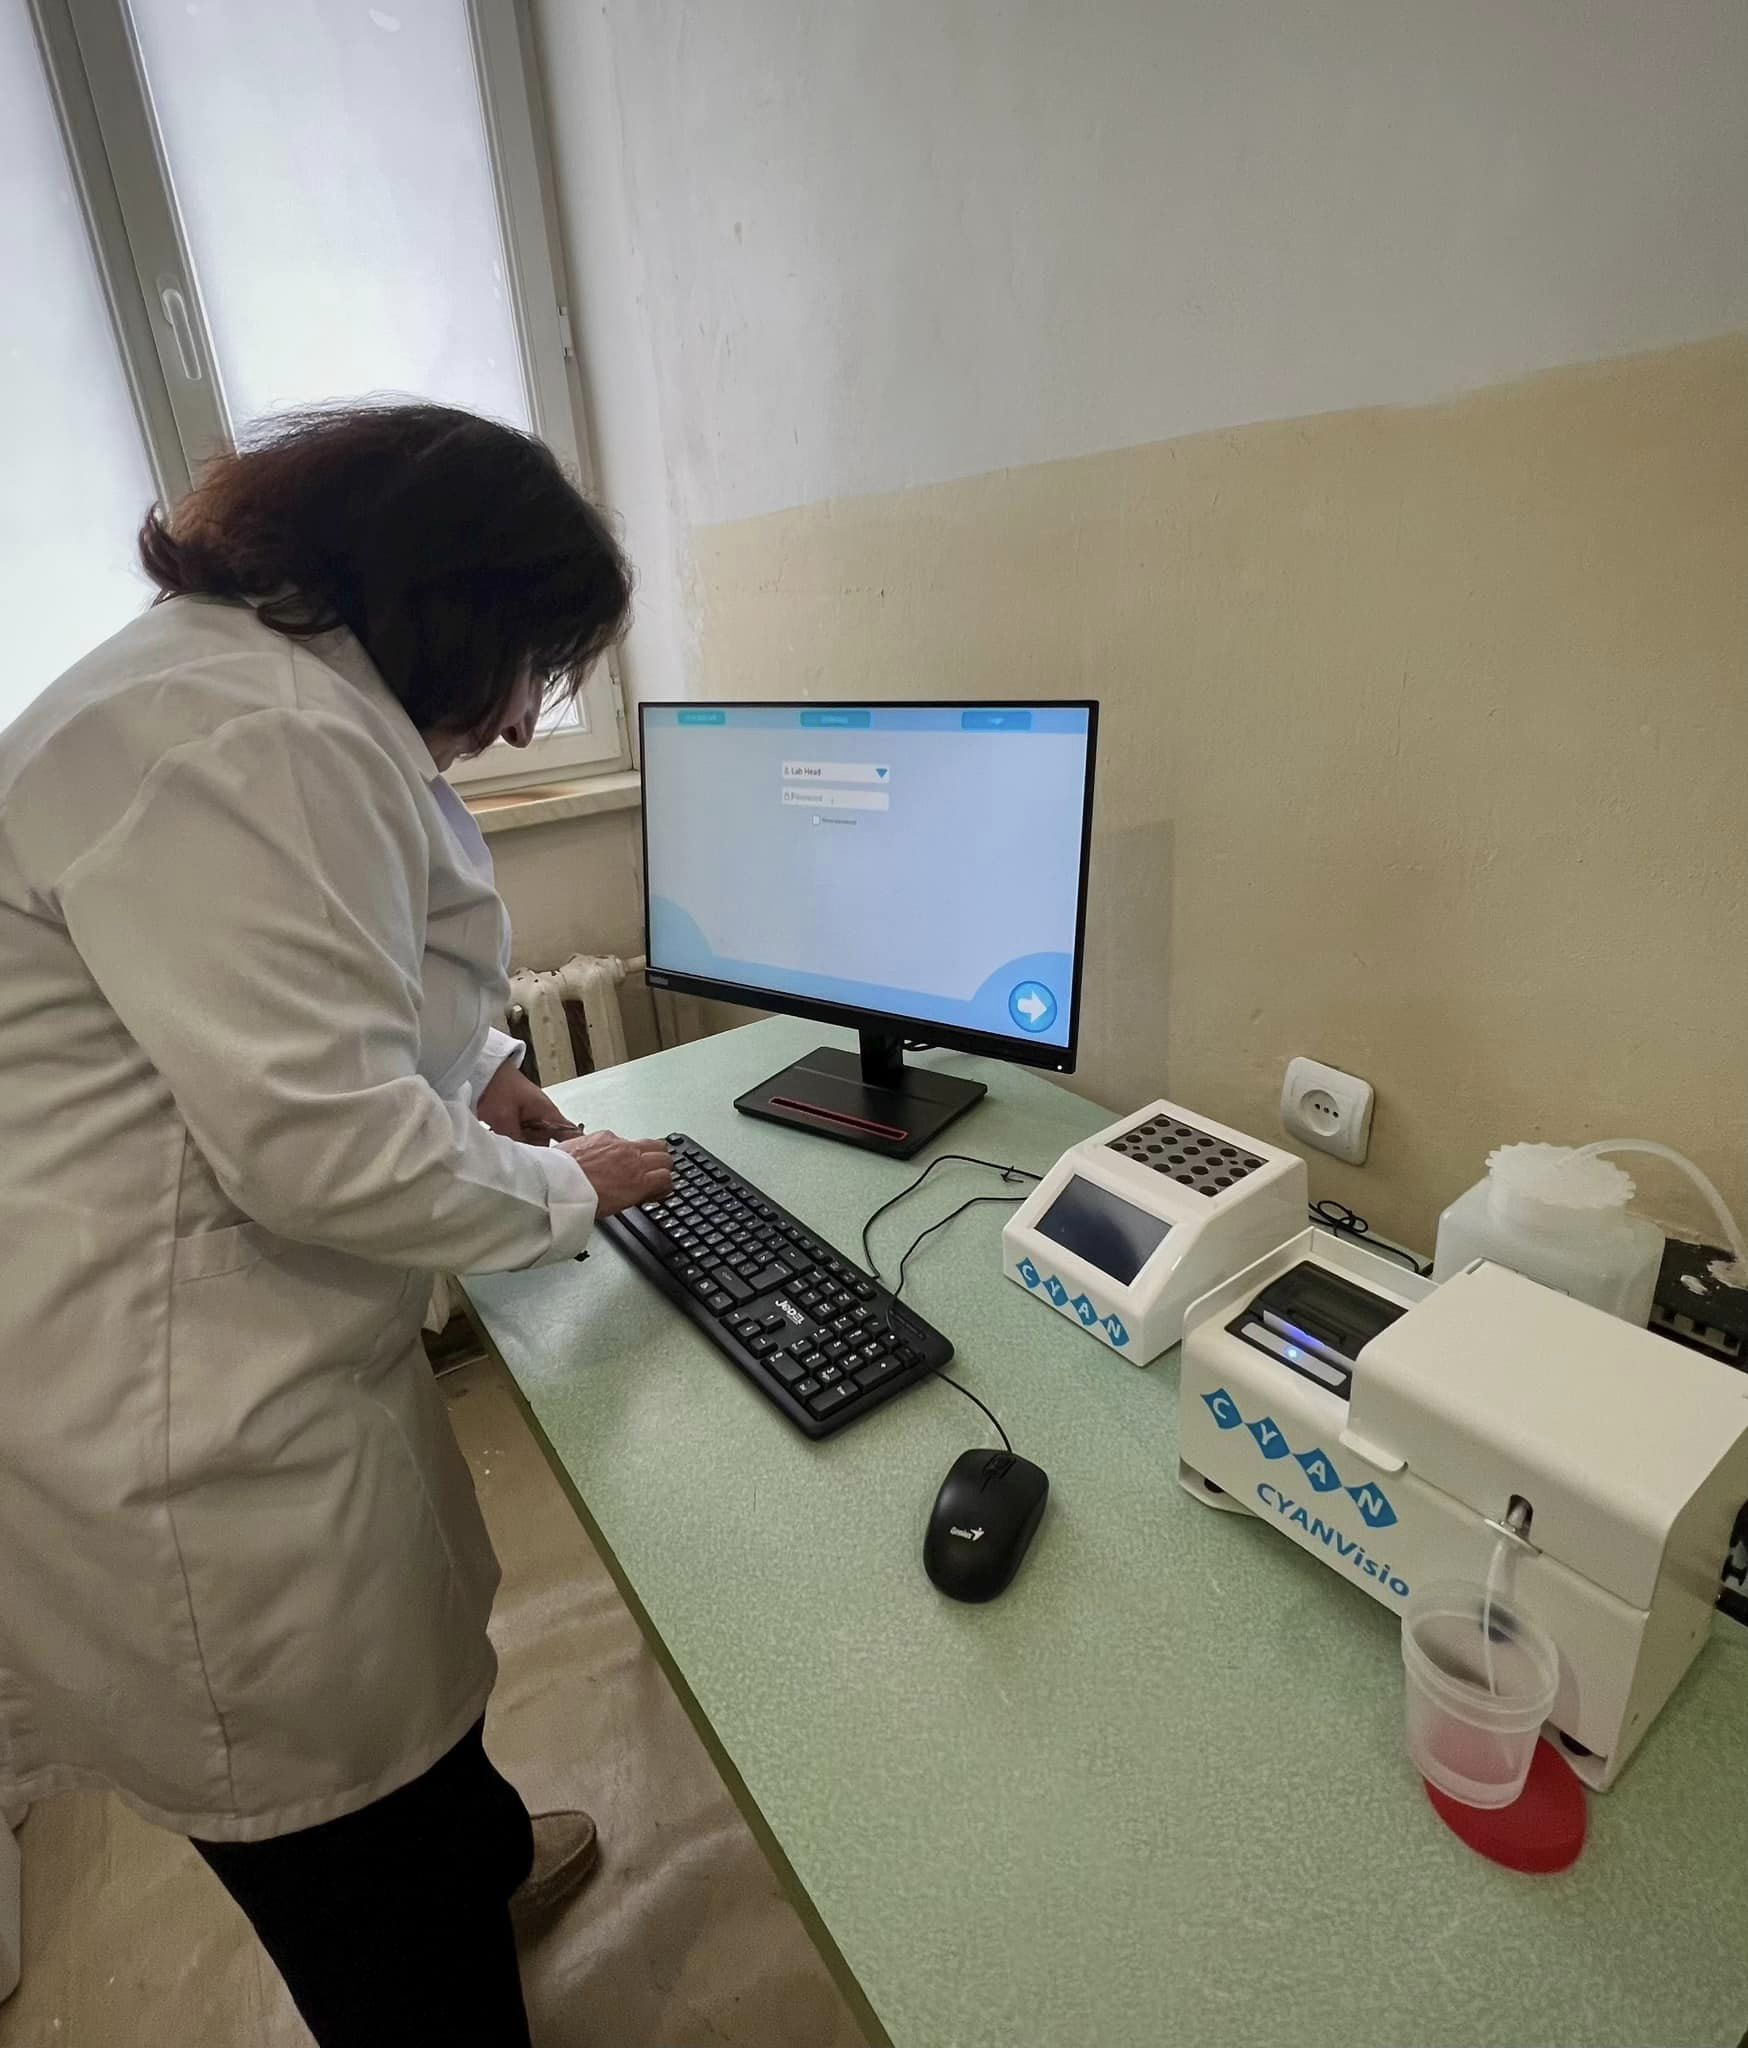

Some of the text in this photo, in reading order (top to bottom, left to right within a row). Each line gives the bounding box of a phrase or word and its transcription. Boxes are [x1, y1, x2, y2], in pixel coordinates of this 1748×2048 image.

[791, 767, 822, 777] Lab Head
[1021, 1263, 1121, 1339] CYAN
[1212, 1396, 1384, 1518] CYAN
[1256, 1482, 1410, 1597] CYANVisio
